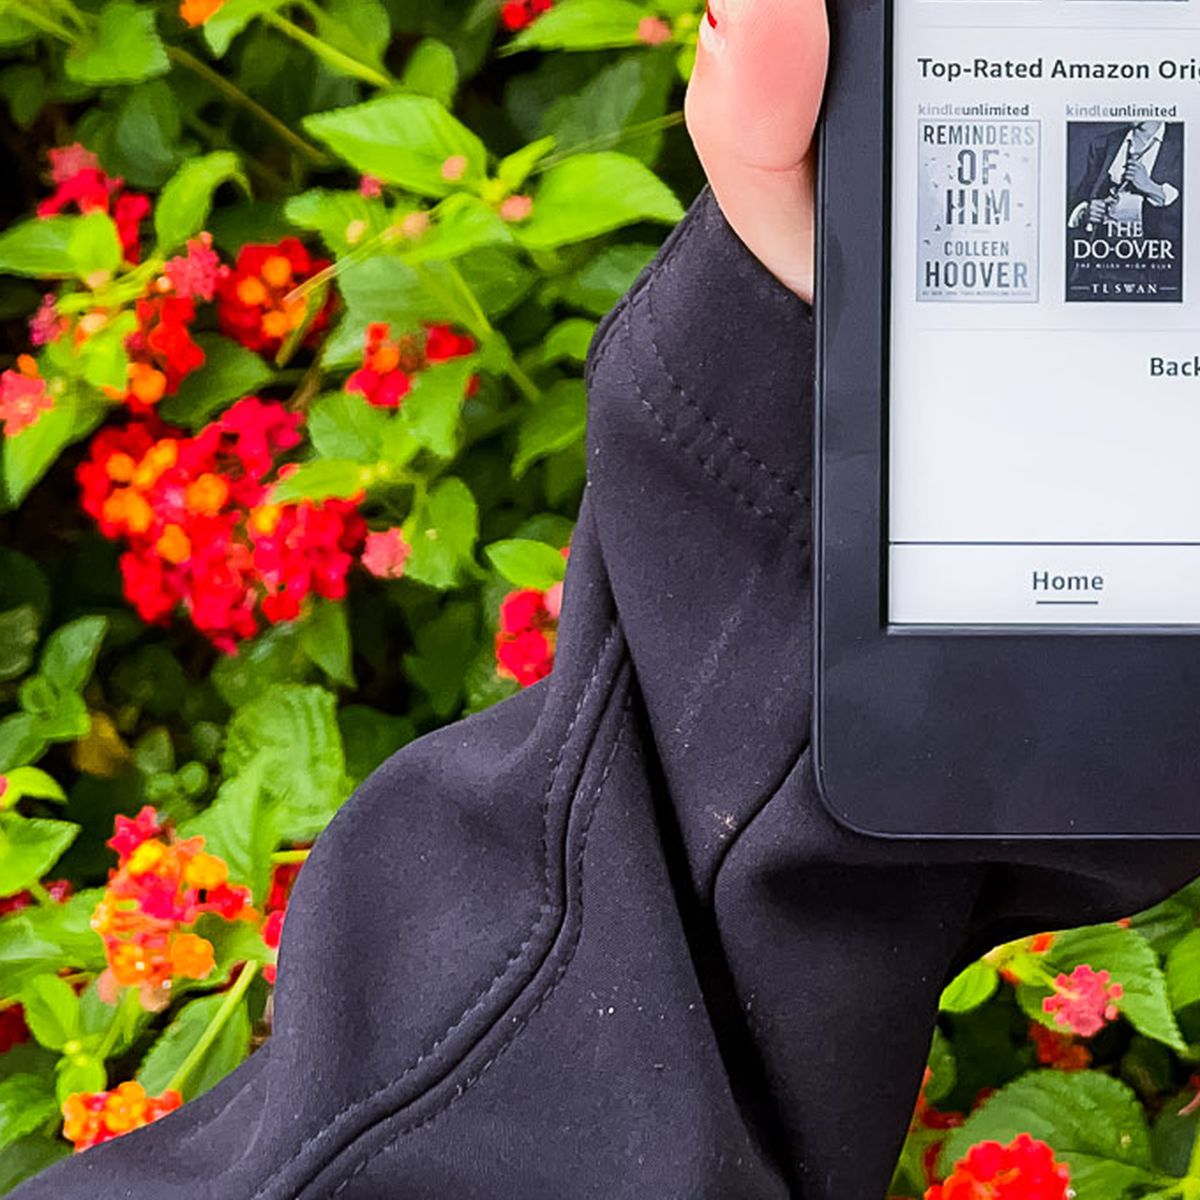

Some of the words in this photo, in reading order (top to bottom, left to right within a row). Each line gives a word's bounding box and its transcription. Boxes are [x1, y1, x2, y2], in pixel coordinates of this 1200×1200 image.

[917, 58, 1043, 83] Top-Rated
[1051, 59, 1150, 80] Amazon
[918, 104, 1030, 117] kindleunlimited
[1065, 105, 1177, 118] kindleunlimited
[923, 125, 1035, 146] REMINDERS
[957, 149, 1000, 186] OF
[946, 189, 1010, 225] HIM
[1103, 221, 1144, 238] THE
[944, 241, 1010, 257] COLLEEN
[1073, 239, 1175, 260] DO-OVER
[925, 261, 1028, 288] HOOVER
[1114, 283, 1158, 294] SWAN
[1032, 570, 1104, 592] Home
